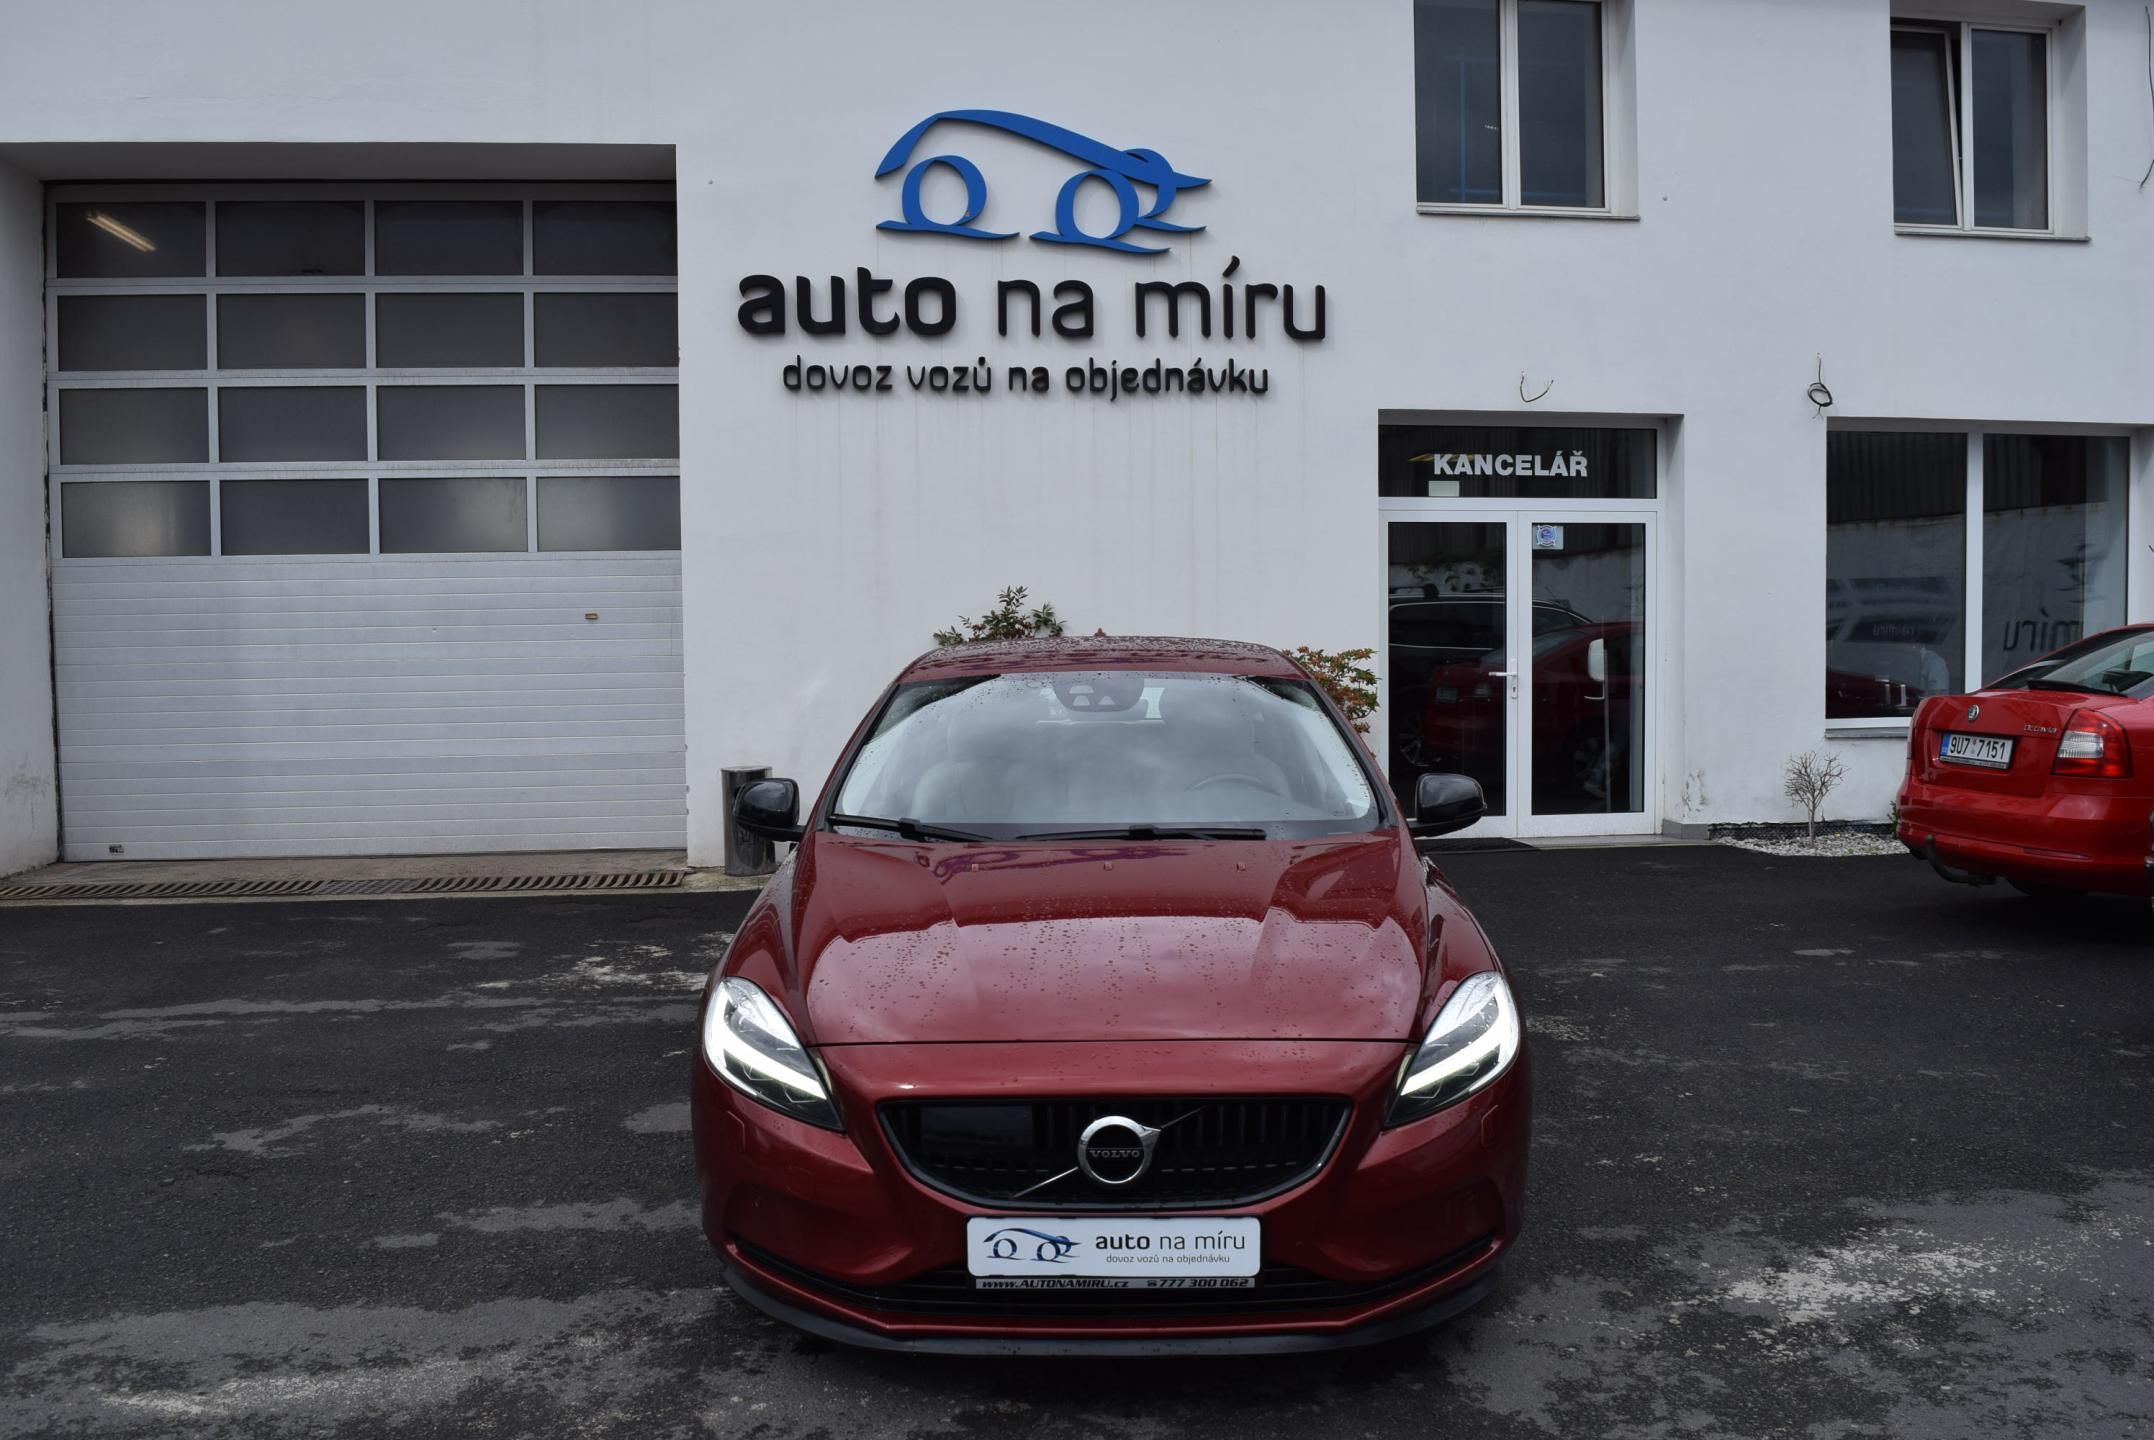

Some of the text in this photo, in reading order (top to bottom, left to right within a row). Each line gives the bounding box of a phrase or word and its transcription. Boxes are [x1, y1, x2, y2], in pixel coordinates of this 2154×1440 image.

[738, 255, 1326, 340] auto na míru
[782, 355, 1269, 401] dovoz vozů na objednávku
[1434, 450, 1588, 477] KANCELÁŘ
[1949, 736, 2006, 760] 9U7 7151
[1089, 1150, 1140, 1158] VOLVO
[1095, 1230, 1245, 1250] auto na míru
[1106, 1254, 1134, 1263] dovoz
[1137, 1254, 1159, 1263] vozů
[1176, 1254, 1230, 1265] objednávku
[1159, 1278, 1187, 1288] 777
[1189, 1278, 1219, 1288] 300
[1221, 1278, 1249, 1288] 062
